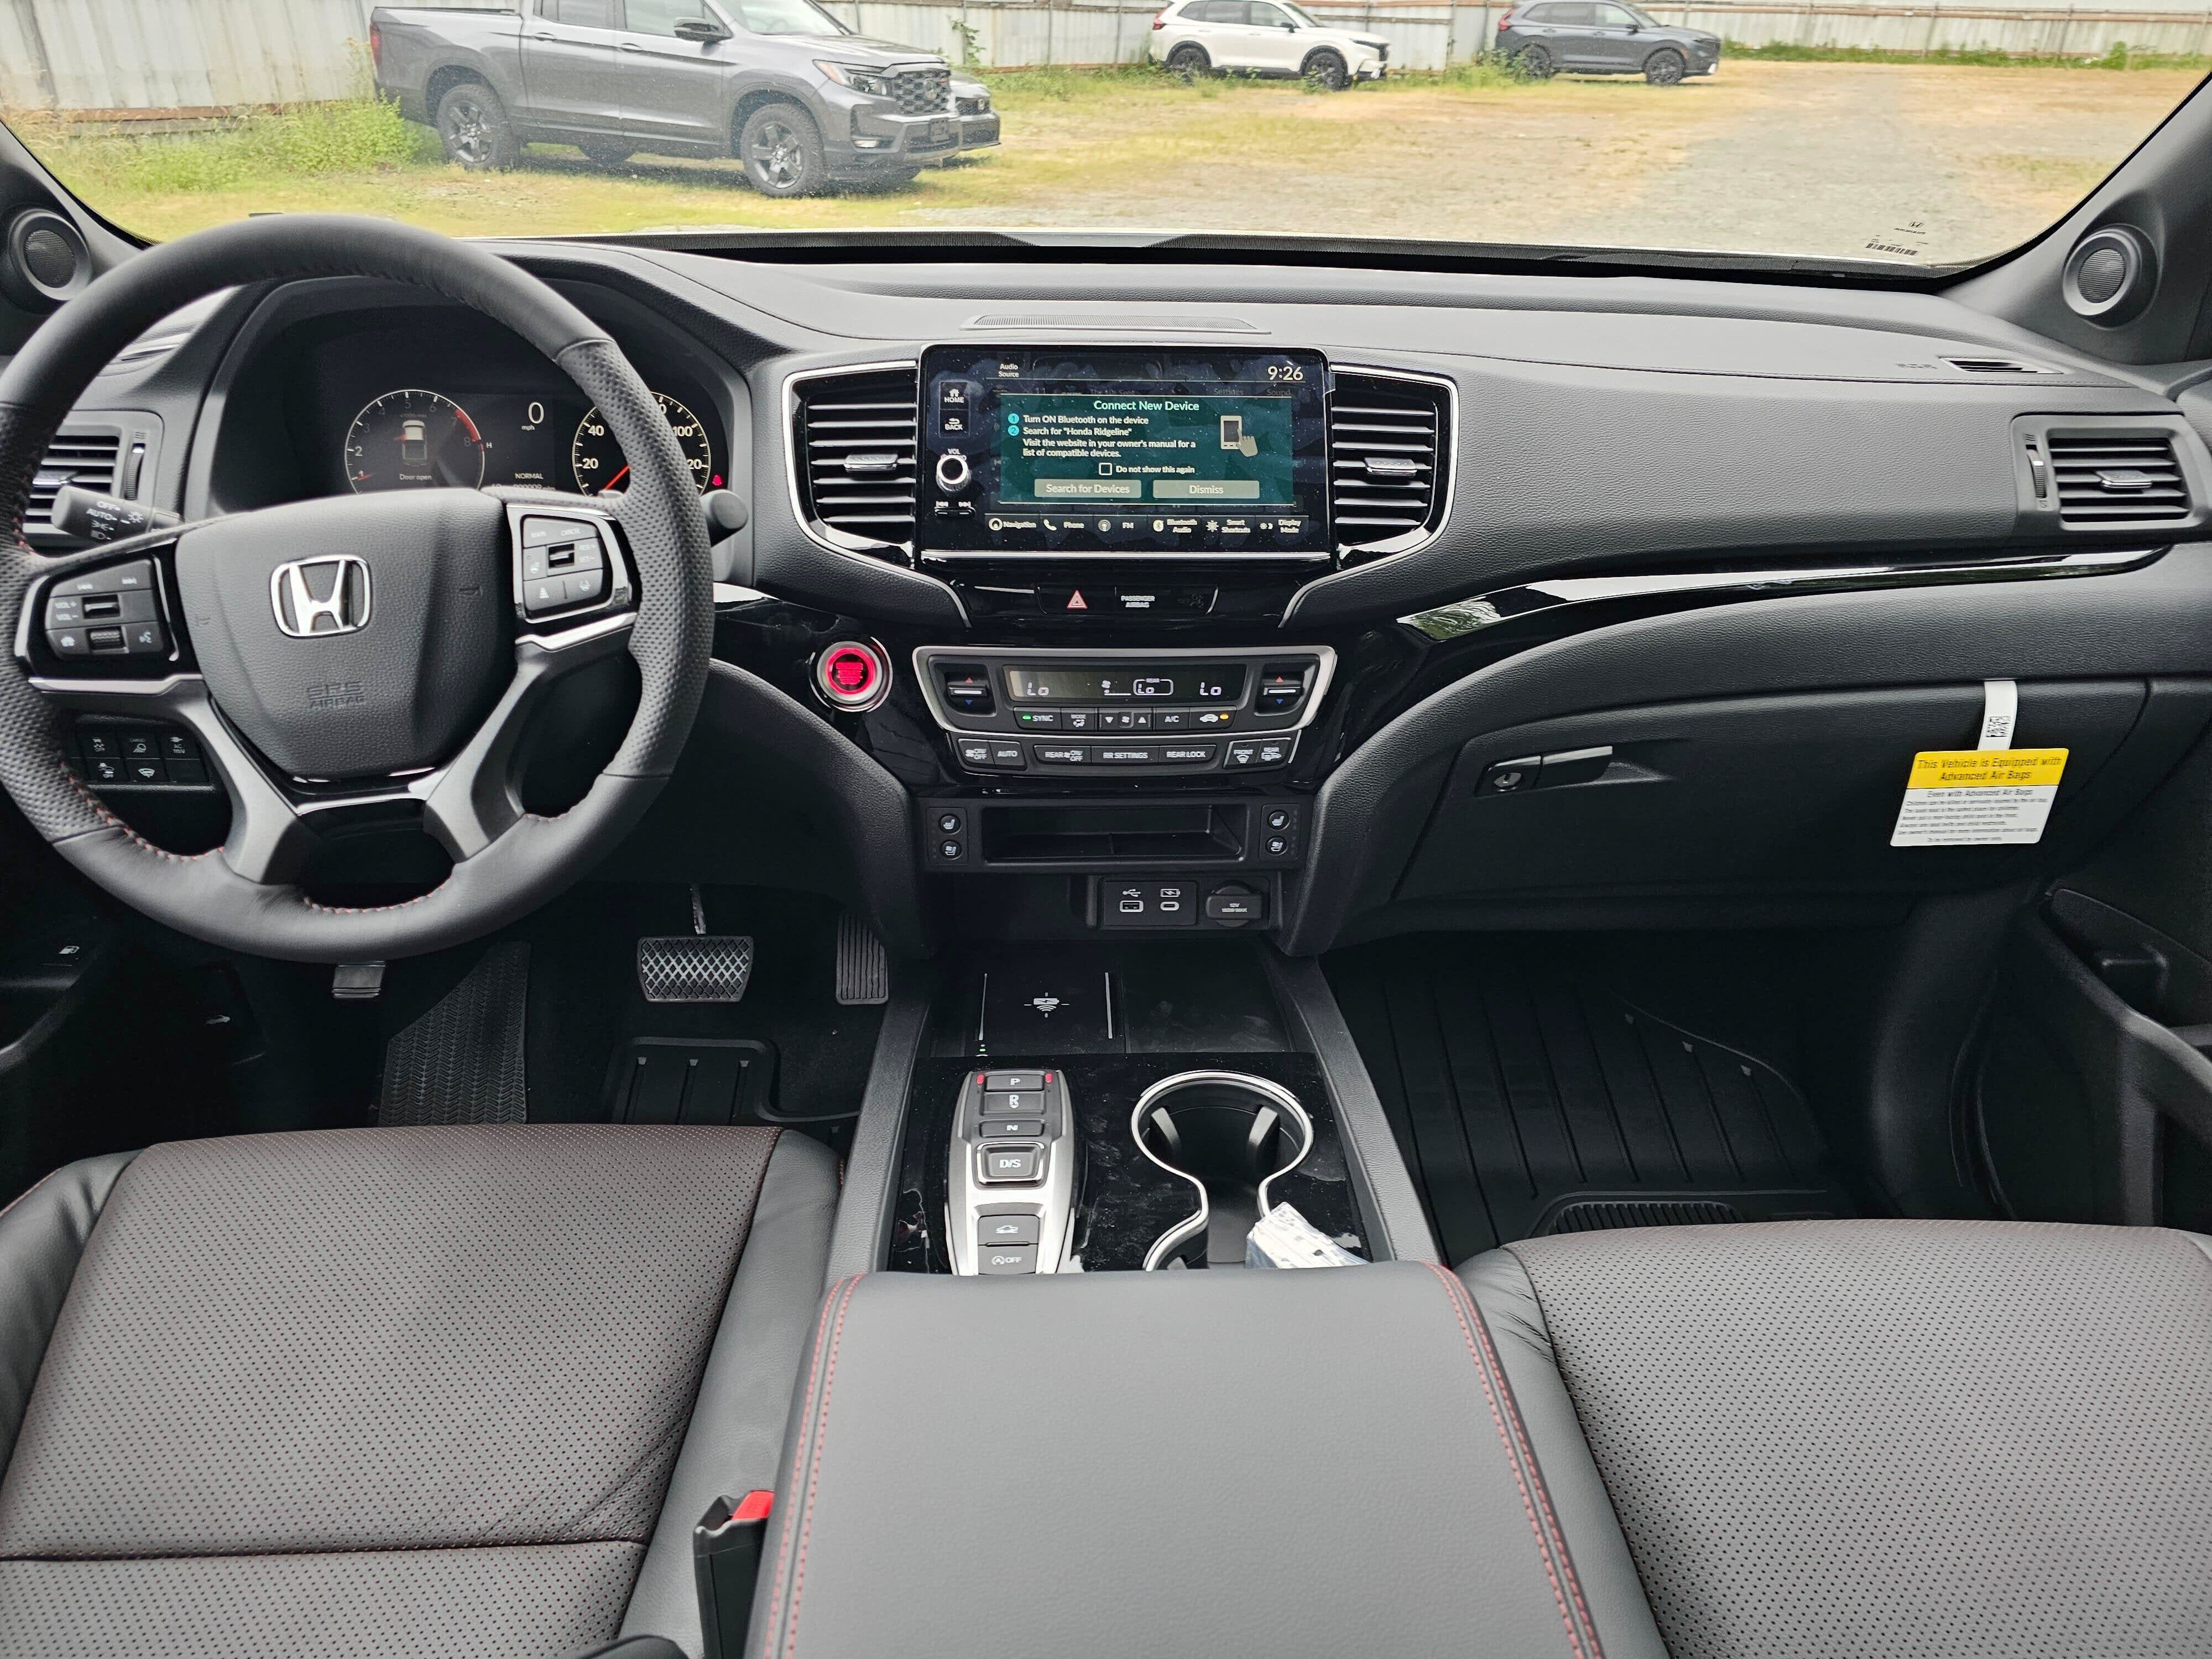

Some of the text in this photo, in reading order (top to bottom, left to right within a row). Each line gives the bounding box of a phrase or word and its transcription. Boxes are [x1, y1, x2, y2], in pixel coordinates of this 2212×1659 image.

[1267, 366, 1303, 380] 9:26
[1094, 401, 1199, 410] Connect New Device
[528, 402, 544, 424] 0
[588, 425, 604, 436] 40
[672, 426, 693, 437] 100
[1094, 428, 1132, 437] Ridgeline"
[1023, 439, 1041, 447] Visit
[355, 446, 363, 456] 2
[1046, 449, 1088, 458] compatible
[1091, 449, 1121, 457] devices.
[582, 458, 599, 469] 20
[1046, 484, 1130, 494] Search for Devices
[1189, 485, 1224, 494] Dismiss
[86, 508, 113, 520] AUTO
[1917, 757, 2062, 769] This Vehicle is Equipped with
[1938, 771, 2032, 780] Advanced Air Bags
[1009, 1095, 1019, 1105] R
[999, 1159, 1021, 1168] D/S
